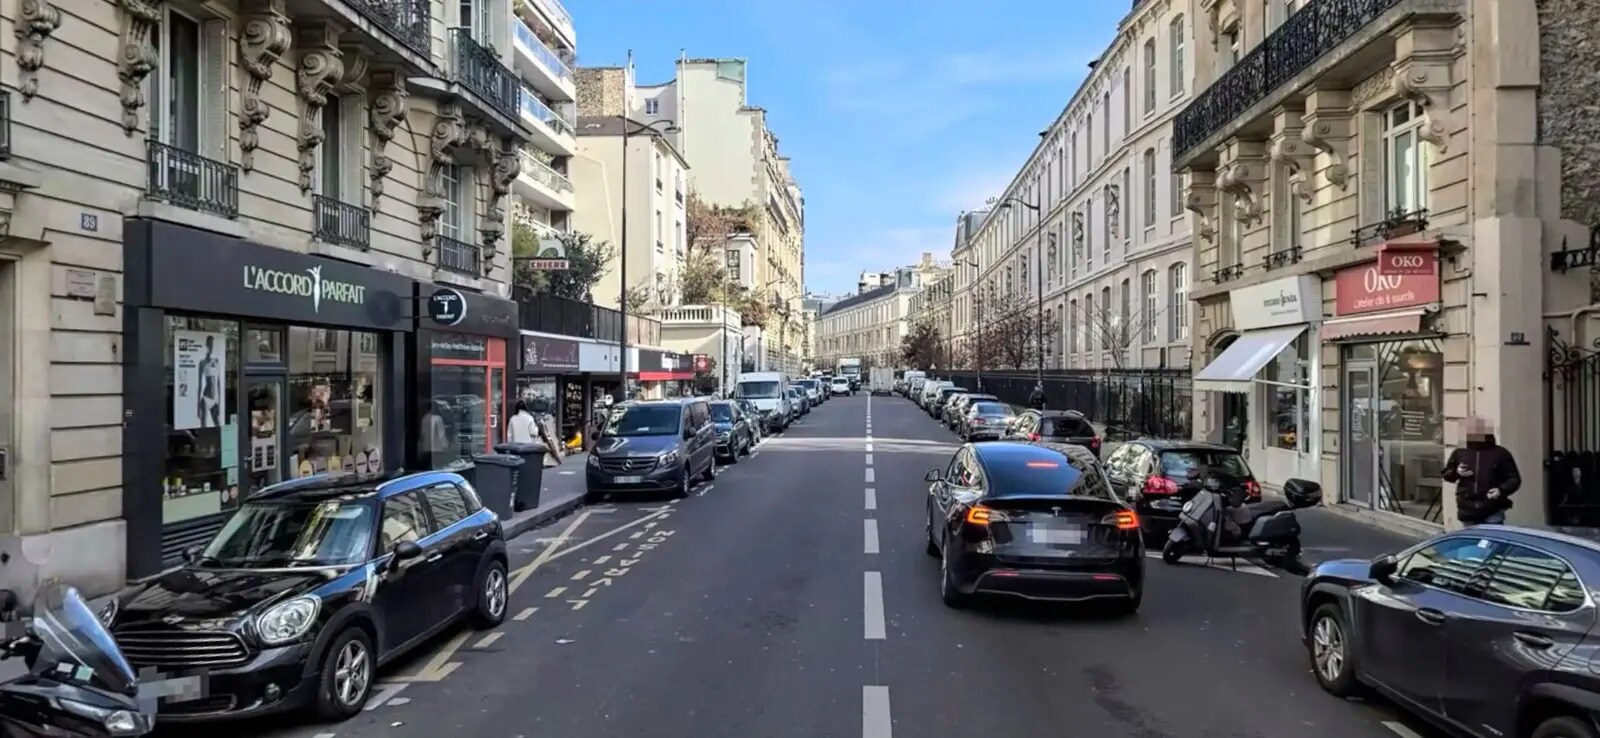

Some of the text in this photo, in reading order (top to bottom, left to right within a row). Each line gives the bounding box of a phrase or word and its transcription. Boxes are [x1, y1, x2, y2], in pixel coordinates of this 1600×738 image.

[83, 214, 96, 229] 89
[1391, 255, 1424, 268] OKO
[243, 265, 365, 304] L'ACCORD PARFAIT
